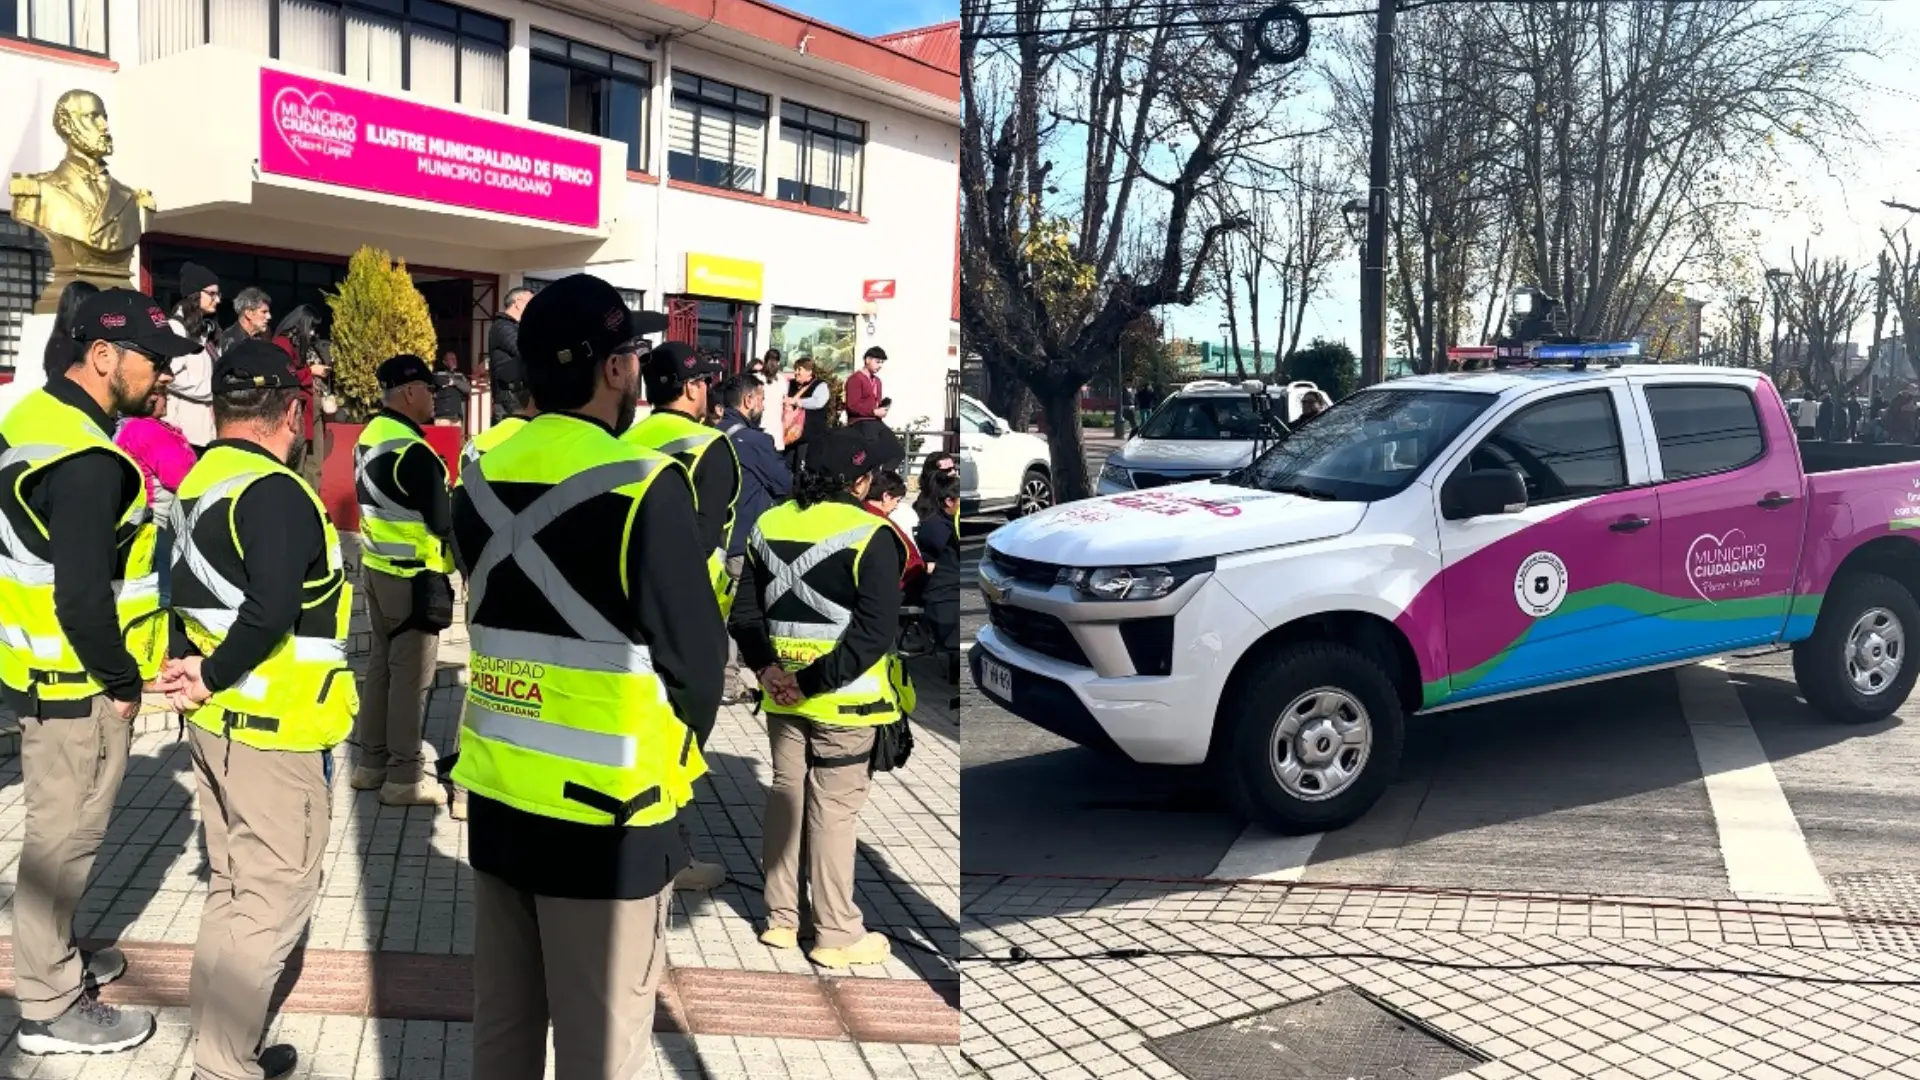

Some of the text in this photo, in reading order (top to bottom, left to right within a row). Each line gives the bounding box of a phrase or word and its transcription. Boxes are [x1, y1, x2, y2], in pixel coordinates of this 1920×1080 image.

[281, 101, 357, 130] MUNICIPIO
[281, 116, 357, 142] CIUDADANO
[365, 123, 594, 187] ILUSTRE MUNICIPALIDAD DE PENCO
[416, 157, 552, 198] MUNICIPIO CIUDADANO
[1694, 543, 1767, 564] MUNICIPIO
[1693, 558, 1766, 578] CIUDADANO
